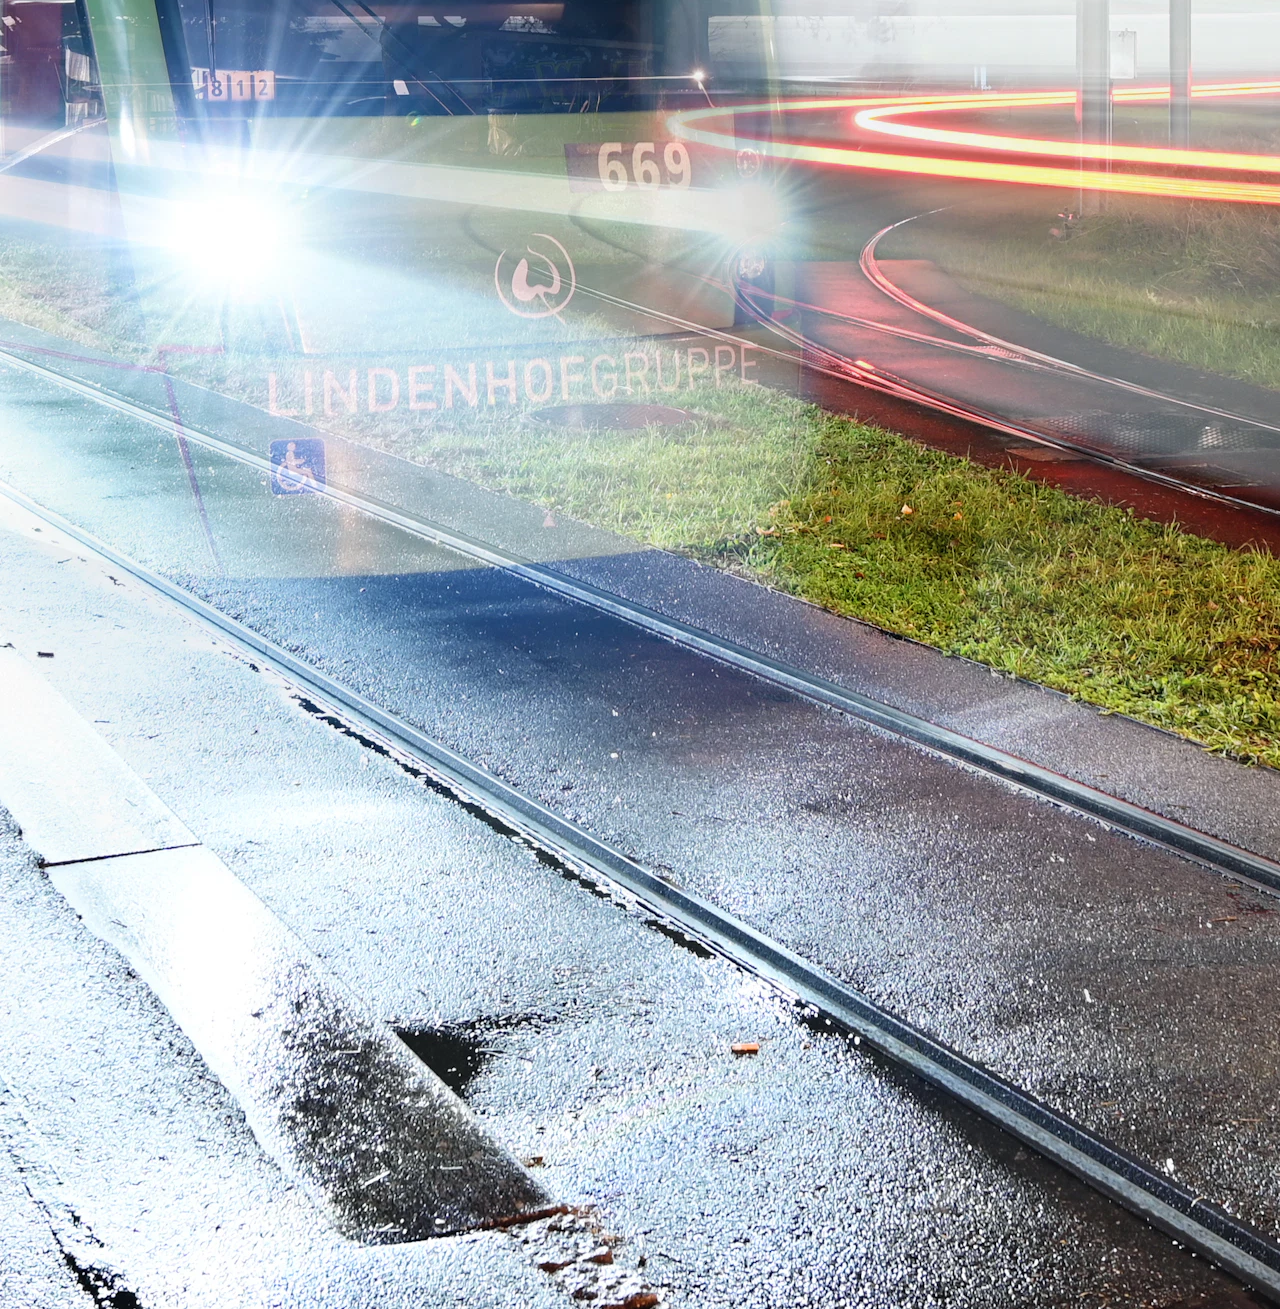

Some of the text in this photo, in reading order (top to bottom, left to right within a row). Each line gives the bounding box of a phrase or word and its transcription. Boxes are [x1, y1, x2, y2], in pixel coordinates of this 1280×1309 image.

[211, 79, 269, 97] 812
[596, 141, 693, 192] 669
[267, 343, 760, 418] LINDENHOFGRUPPE
